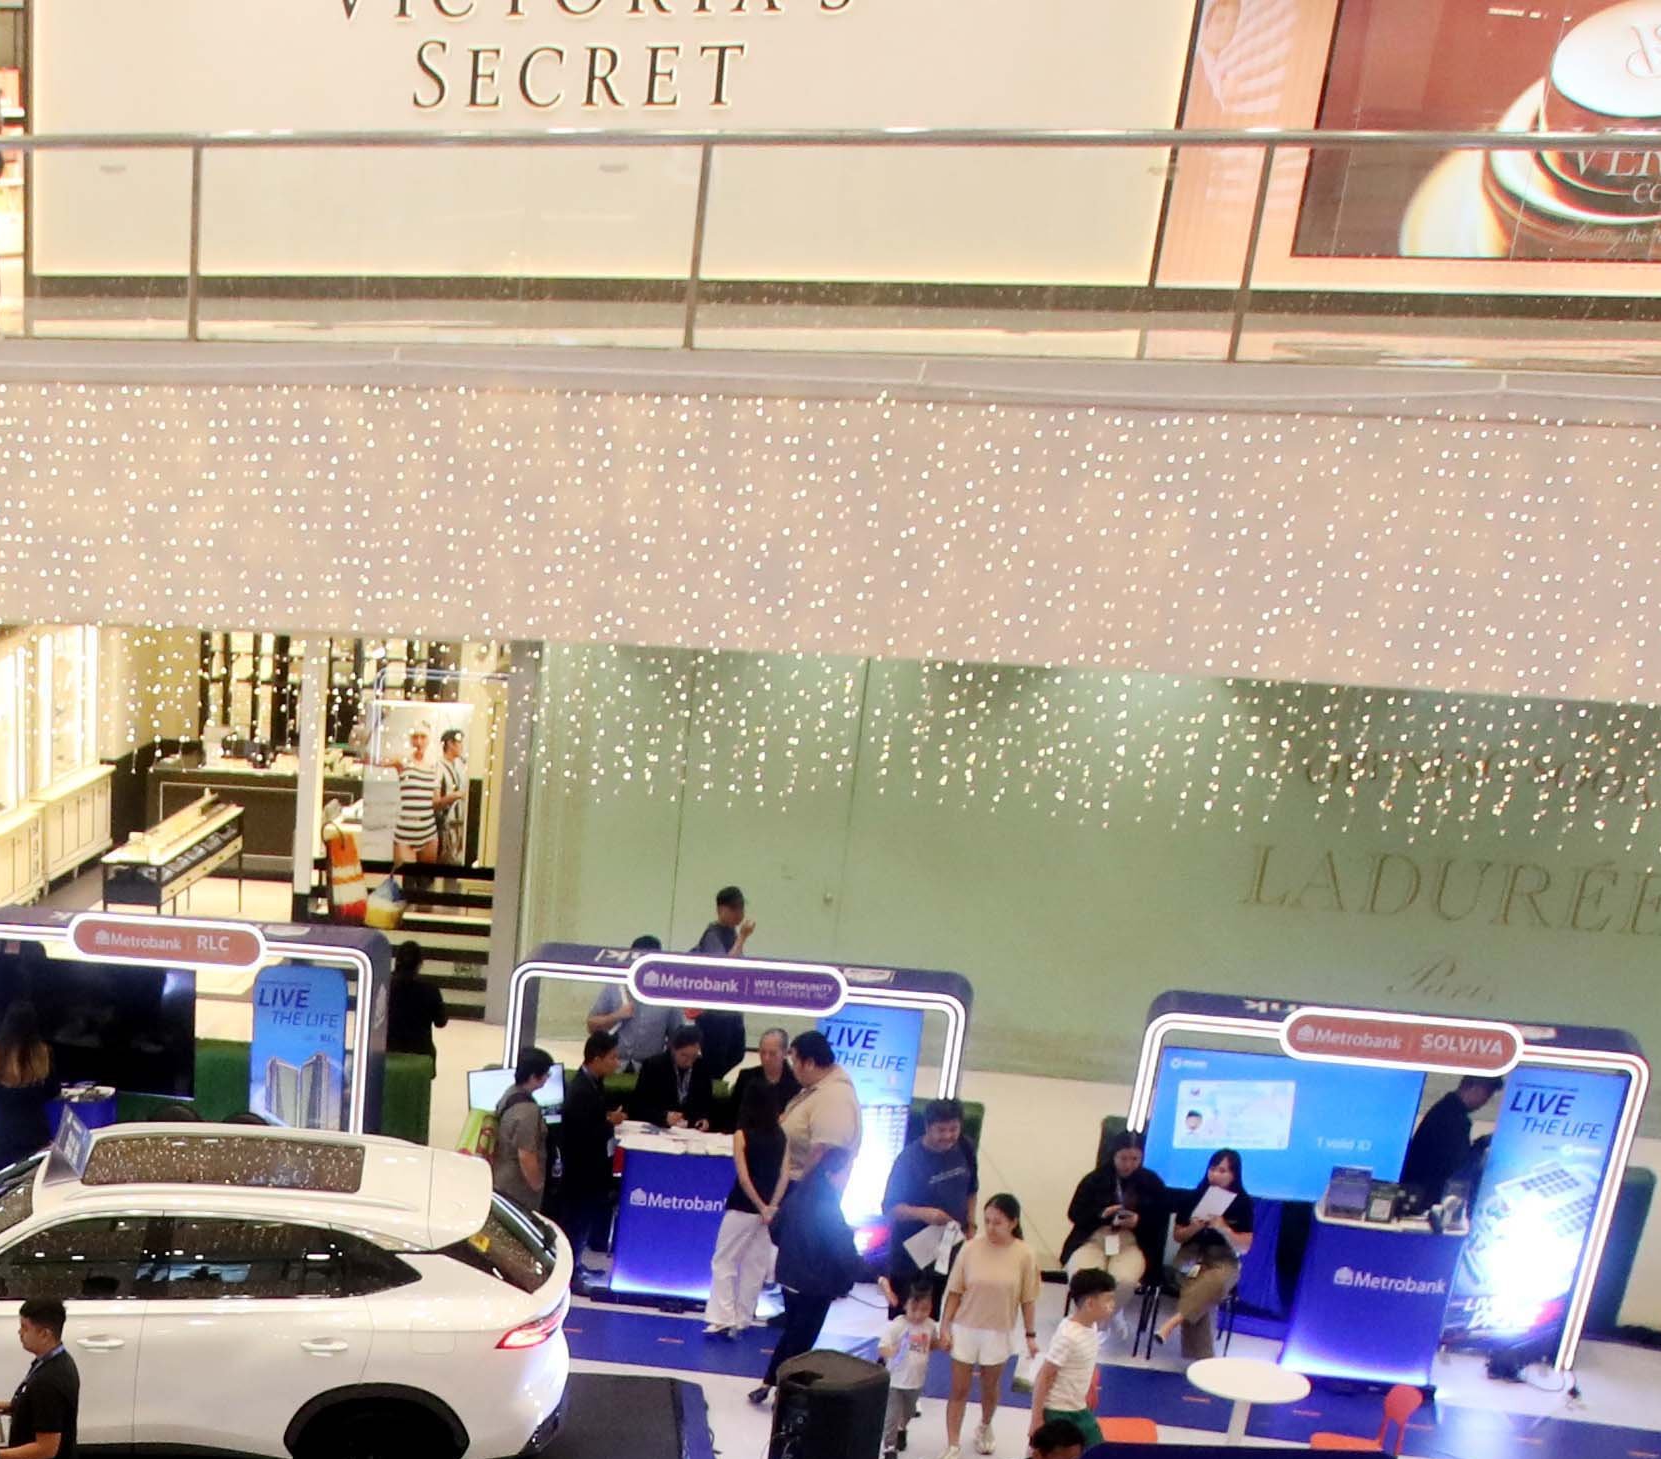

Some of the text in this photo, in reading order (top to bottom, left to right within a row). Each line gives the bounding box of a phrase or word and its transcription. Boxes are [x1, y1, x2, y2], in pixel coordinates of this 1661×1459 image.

[412, 38, 745, 108] SECRET
[110, 933, 229, 951] Metrobank RLC
[660, 970, 739, 992] Metrobank
[258, 987, 311, 1008] LIVE
[272, 1010, 342, 1028] THE LIFE
[825, 1025, 880, 1049] LIVE
[1315, 1030, 1505, 1055] Metrobank SOLVIVA
[836, 1050, 908, 1071] THE LIFE
[1511, 1089, 1576, 1116] LIVE
[1522, 1116, 1605, 1140] THE LIFE
[1354, 1271, 1446, 1294] Metrobank
